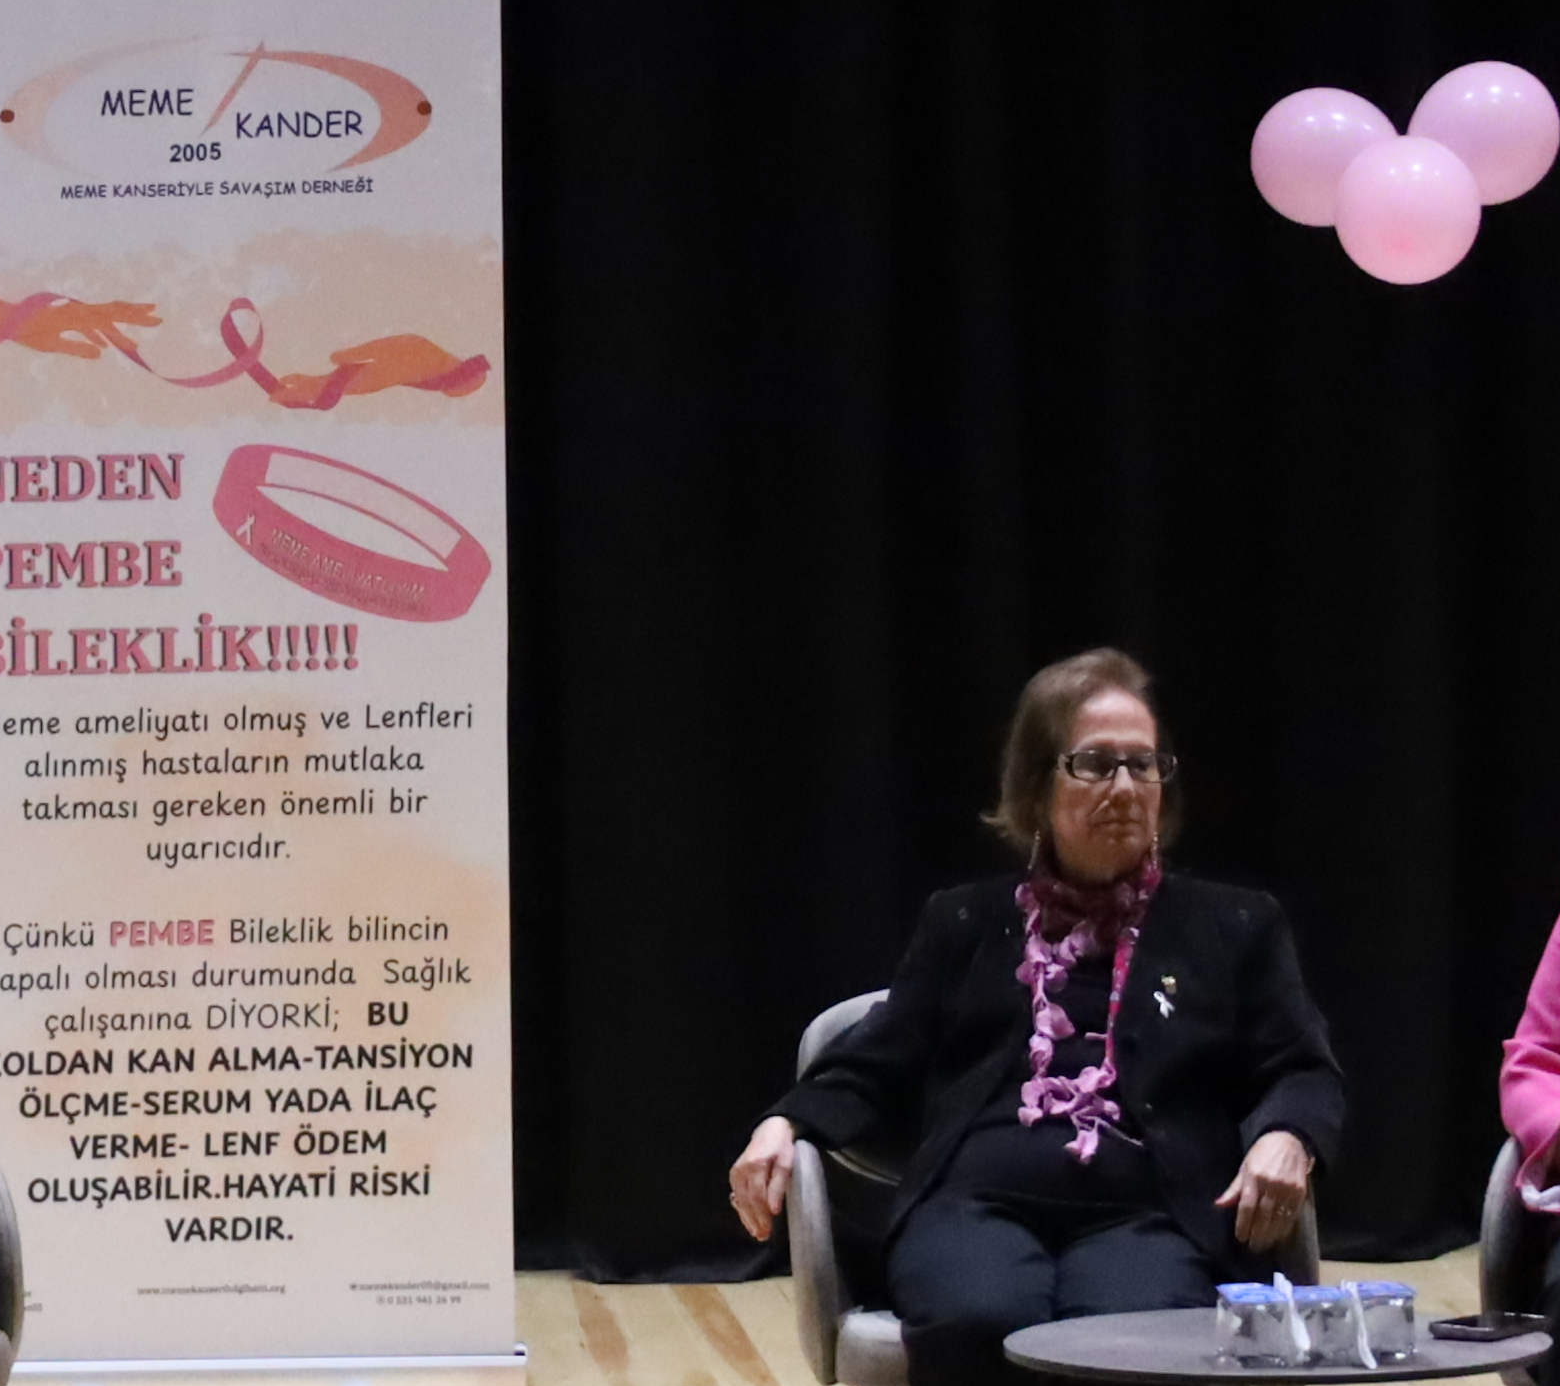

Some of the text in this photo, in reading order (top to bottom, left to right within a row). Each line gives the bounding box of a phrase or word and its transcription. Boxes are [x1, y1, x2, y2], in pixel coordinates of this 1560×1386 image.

[100, 88, 363, 139] MEME KANDER
[169, 142, 222, 163] 2005
[60, 175, 374, 199] MEME KANSERİYLE SAVAŞIM DERNEĞİ
[74, 707, 208, 742] ameliyatı
[223, 706, 306, 739] olmuş
[320, 711, 351, 730] ve
[364, 701, 474, 730] Lenfleri
[24, 745, 425, 785] alınmış hastaların mutlaka
[22, 789, 428, 826] takması gereken önemli bir
[145, 834, 291, 868] uyarıcıdır.
[3, 914, 450, 956] Çünkü PEMBE Bileklik bilincin
[84, 963, 177, 990] olması
[191, 961, 356, 989] durumunda
[382, 958, 473, 991] Sağlık
[44, 998, 410, 1040] çalışanına DİYORKİ; BU
[127, 1047, 196, 1075] KAN
[208, 1042, 474, 1074] ALMA-TANSİYON
[18, 1080, 437, 1125] ÖLÇME-SERUM YADA İLAÇ
[69, 1122, 387, 1161] VERME- LENF ÖDEM
[27, 1162, 430, 1209] OLUŞABİLİR.HAYATİ RİSKİ
[165, 1215, 294, 1243] VARDIR.
